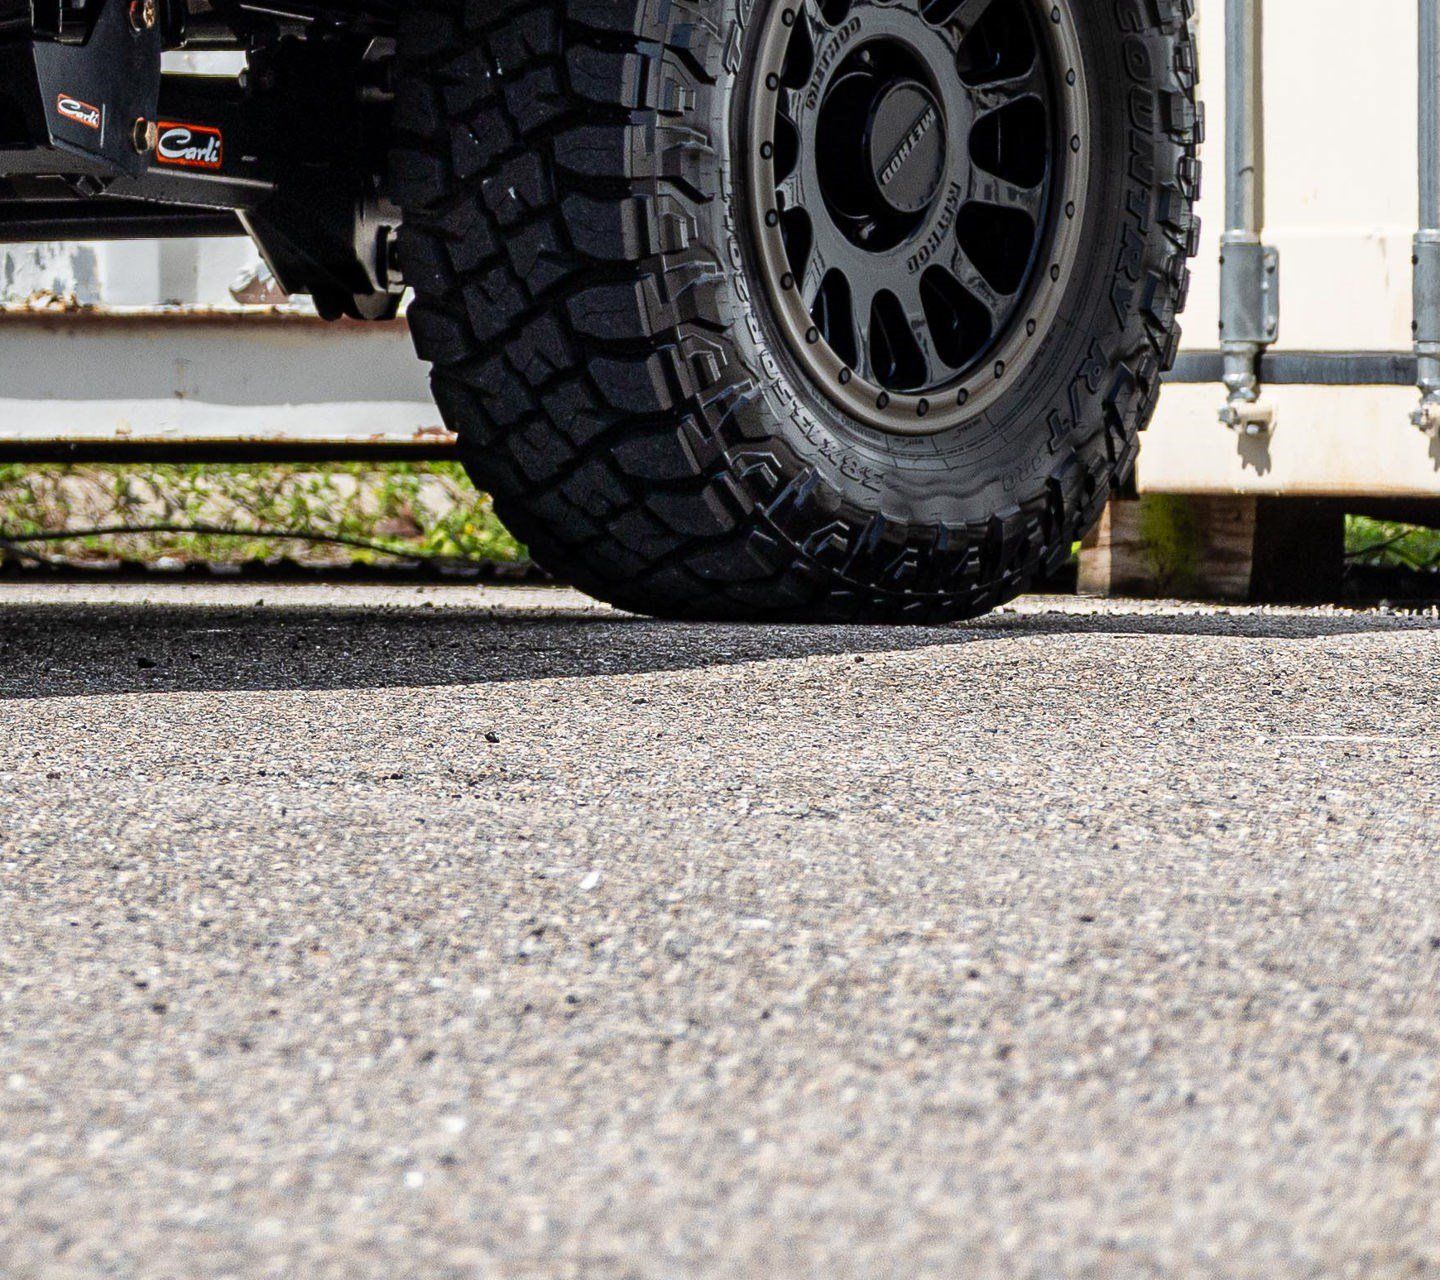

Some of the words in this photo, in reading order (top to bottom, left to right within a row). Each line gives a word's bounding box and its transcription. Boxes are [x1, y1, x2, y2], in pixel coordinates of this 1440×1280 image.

[58, 98, 100, 125] Carli
[158, 127, 221, 163] Carli
[881, 107, 937, 186] METHOD
